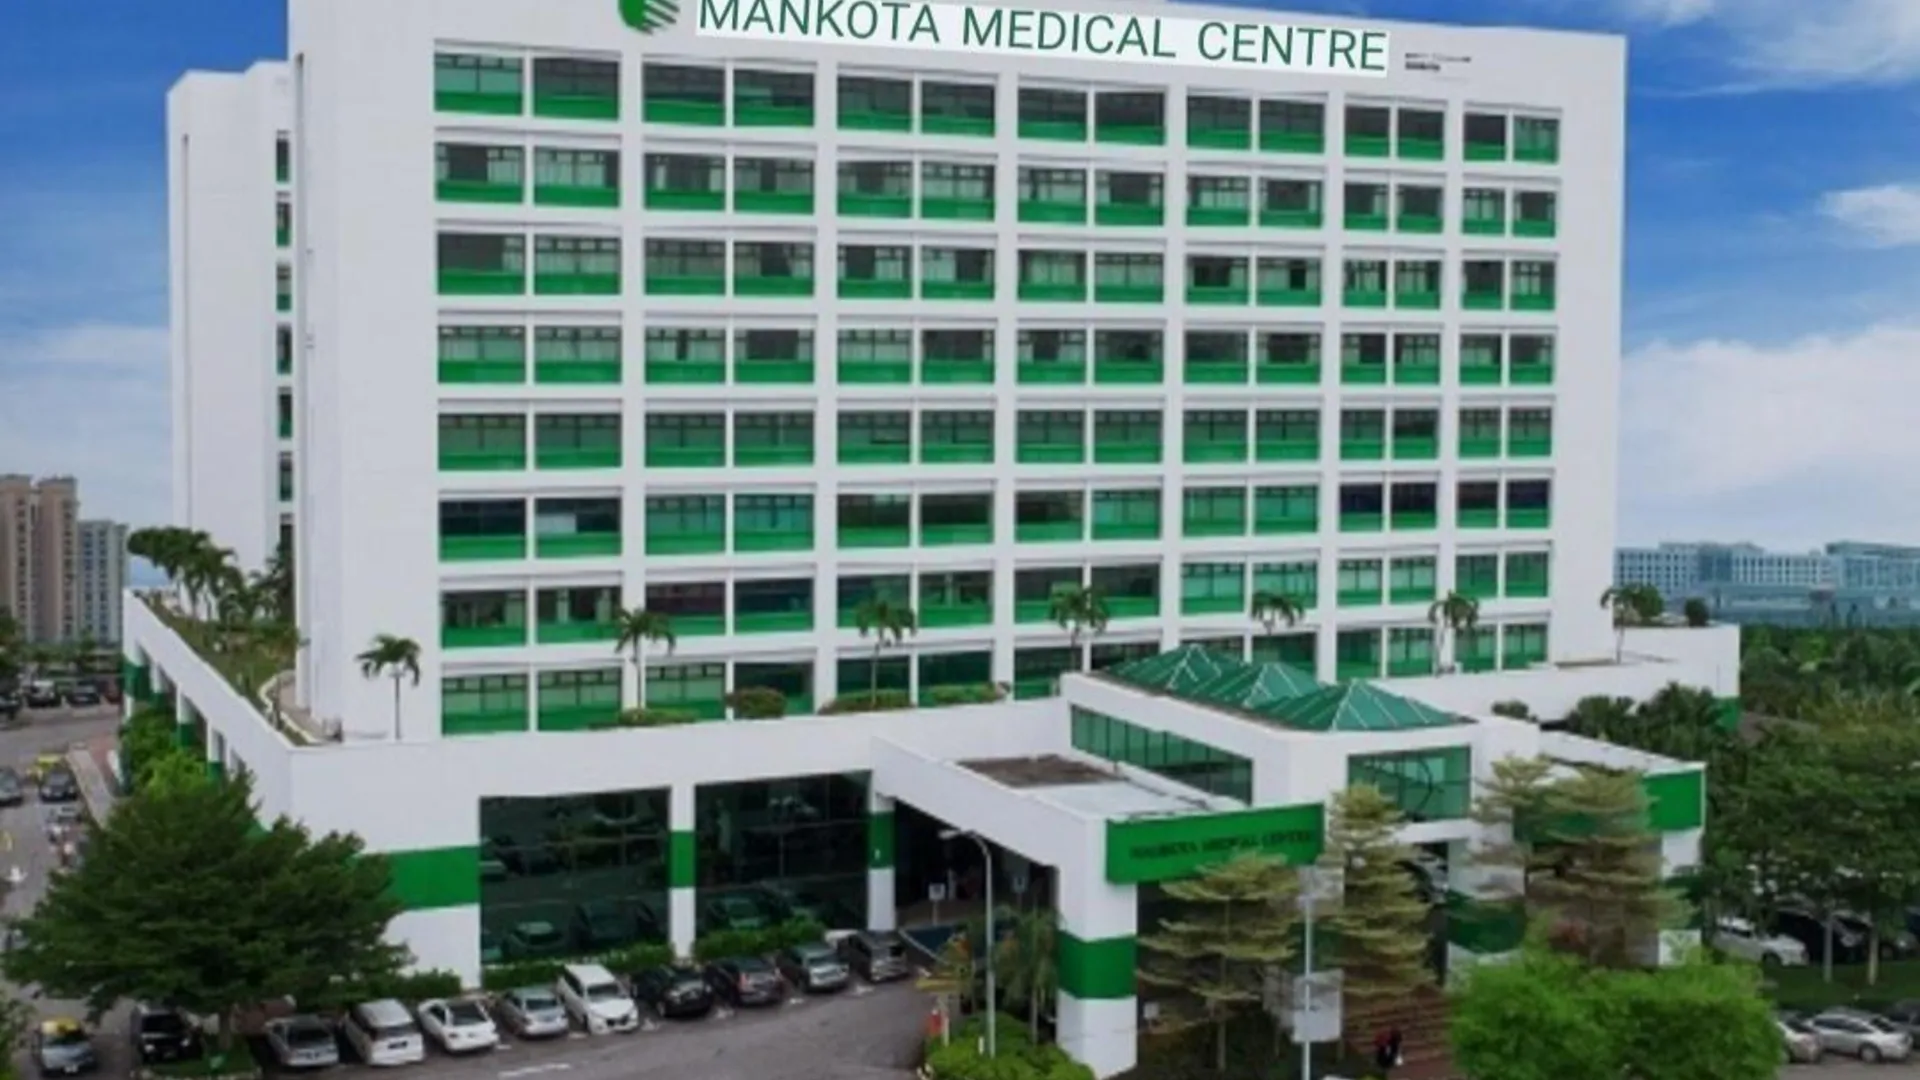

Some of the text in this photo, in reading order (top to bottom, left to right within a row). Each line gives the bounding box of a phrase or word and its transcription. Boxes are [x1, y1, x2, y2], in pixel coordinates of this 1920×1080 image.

[700, 0, 1386, 71] MANKOTA MEDICAL CENTRE
